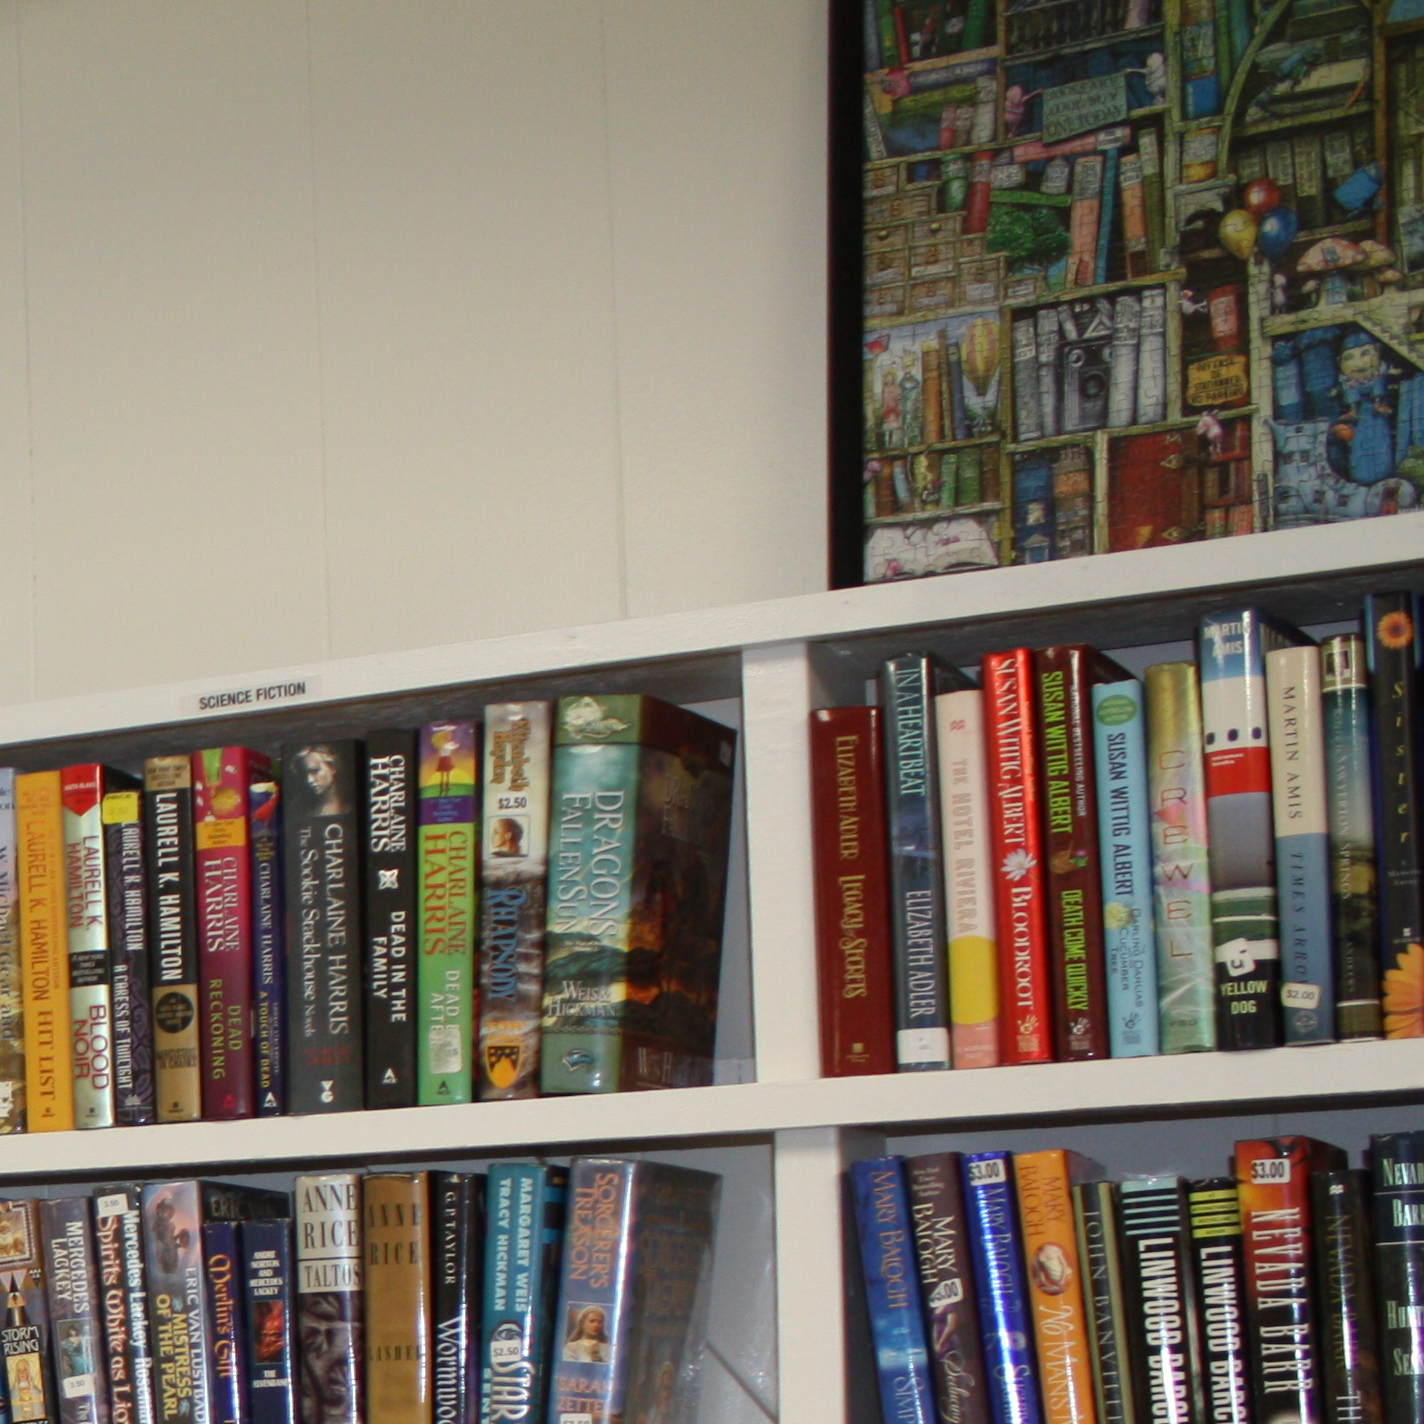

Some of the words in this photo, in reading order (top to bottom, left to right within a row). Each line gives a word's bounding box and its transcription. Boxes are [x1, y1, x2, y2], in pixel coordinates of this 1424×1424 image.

[199, 689, 252, 710] SCIENCE
[256, 682, 306, 701] FICTION
[895, 668, 920, 687] IN
[994, 659, 1018, 717] SUSAN
[1042, 671, 1066, 723] SUSAN
[897, 706, 926, 797] HEARTBEAT
[1282, 686, 1300, 761] MARTIN
[1106, 732, 1130, 781] SUSAN
[370, 756, 390, 853] HARRIS
[389, 754, 406, 852] CHARLAINE
[1048, 780, 1073, 834] ALBERT
[1109, 786, 1131, 837] WITTIG
[1287, 772, 1302, 820] AMIS
[27, 820, 47, 893] LAURELL
[155, 792, 179, 867] LAURELL
[67, 842, 86, 928] HAMILTON
[82, 835, 102, 910] LAURELL
[158, 872, 179, 888] K.
[300, 849, 320, 905] Sookie
[324, 823, 347, 948] CHARLAINE
[424, 833, 448, 956] HARRIS
[449, 830, 468, 956] CHARLAINE
[590, 790, 625, 937] DRAGONS
[1113, 844, 1134, 897] ALBERT
[204, 859, 225, 953] HARRIS
[221, 856, 240, 952] CHARLAINE
[956, 858, 978, 934] RIVIERA
[1061, 890, 1084, 926] DEATH
[159, 894, 183, 981] HAMILTON
[302, 907, 322, 1000] Stackhouse
[390, 911, 406, 958] DEAD
[906, 889, 933, 967] ELIZABETH
[1011, 886, 1034, 1007] BLOODROOT
[1063, 929, 1086, 961] COME
[30, 920, 50, 1001] HAMILTON
[372, 936, 388, 999] FAMILY
[390, 965, 406, 982] IN
[1065, 963, 1089, 1010] QUICKLY
[1219, 979, 1269, 996] YELLOW
[327, 954, 348, 1035] HARRIS
[390, 989, 406, 1023] THE
[909, 970, 937, 1018] ADLER
[1230, 1000, 1258, 1015] DOG
[74, 1020, 90, 1079] NOIR
[89, 1005, 109, 1090] BLOOD
[209, 979, 226, 1081] RECKONING
[228, 1004, 243, 1051] DEAD
[303, 1184, 358, 1213] ANNE
[498, 1177, 511, 1229] TRACY
[516, 1177, 533, 1267] MARGARET
[871, 1171, 897, 1224] MARY
[97, 1216, 121, 1286] Spirits
[123, 1210, 145, 1287] Mercedes
[303, 1220, 358, 1249] RICE
[570, 1187, 596, 1280] TREASON
[912, 1203, 939, 1284] BALOGH
[932, 1215, 958, 1278] MARY
[1251, 1206, 1308, 1310] NEVADA
[52, 1238, 72, 1301] LACKEY
[66, 1221, 90, 1314] MERCEDES
[186, 1267, 198, 1306] ERIC
[306, 1263, 360, 1289] TALTOS
[494, 1235, 511, 1311] HICKMAN
[516, 1273, 530, 1313] WEIS
[880, 1230, 908, 1309] BALOGH
[1138, 1237, 1182, 1346] LINWOOD
[1200, 1245, 1241, 1352] LINWOOD
[2, 1326, 39, 1342] STORM
[105, 1288, 127, 1354] White
[130, 1292, 149, 1349] Lackey
[156, 1294, 171, 1318] OF
[188, 1309, 201, 1343] VAN
[3, 1339, 39, 1356] RISING
[111, 1357, 126, 1381] as
[158, 1324, 173, 1357] THE
[172, 1313, 192, 1399] MISTRESS
[1259, 1323, 1315, 1394] BARR
[161, 1361, 179, 1420] PEARL
